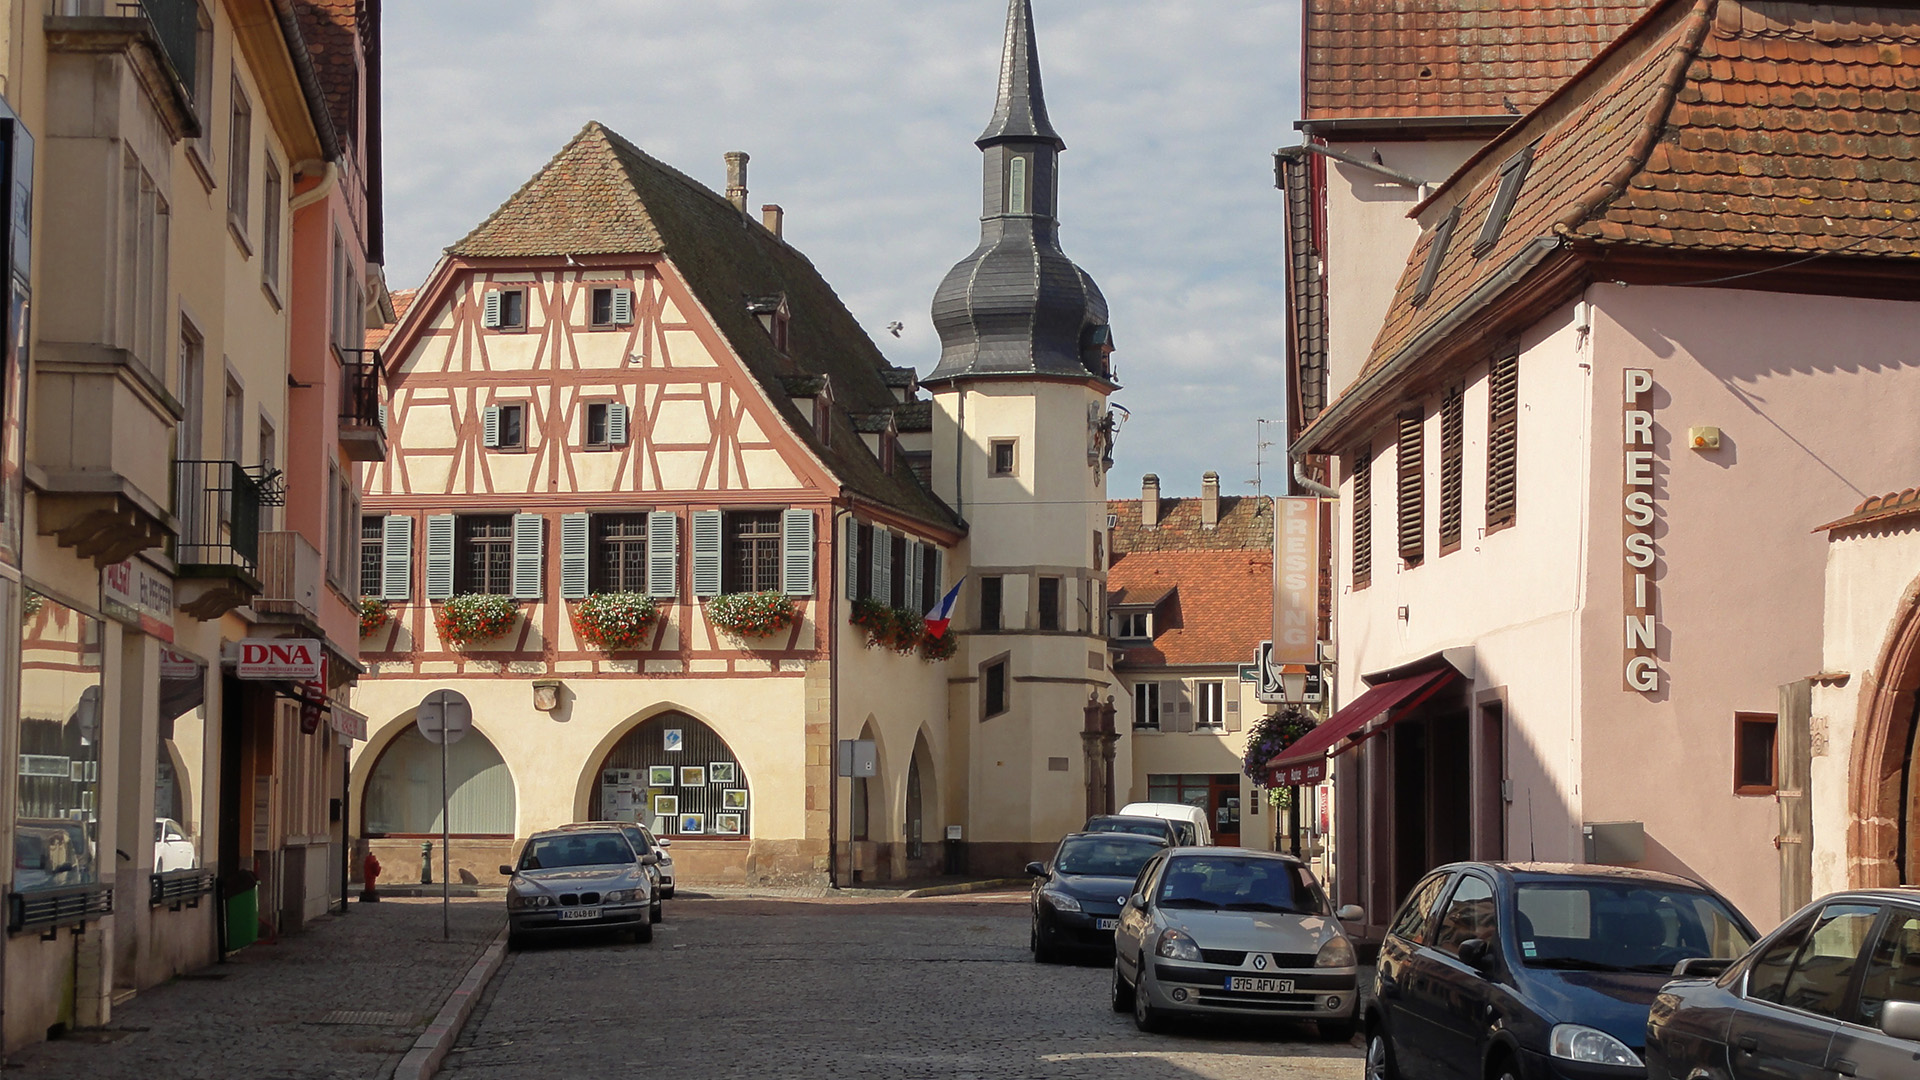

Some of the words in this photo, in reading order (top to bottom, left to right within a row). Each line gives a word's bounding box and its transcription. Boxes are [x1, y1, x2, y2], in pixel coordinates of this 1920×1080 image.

[1625, 369, 1658, 691] PRESSING
[1284, 500, 1308, 645] PRESSING
[242, 644, 314, 665] DNA
[1233, 978, 1252, 991] 375
[1257, 979, 1275, 991] AFV
[1280, 980, 1292, 992] 67
